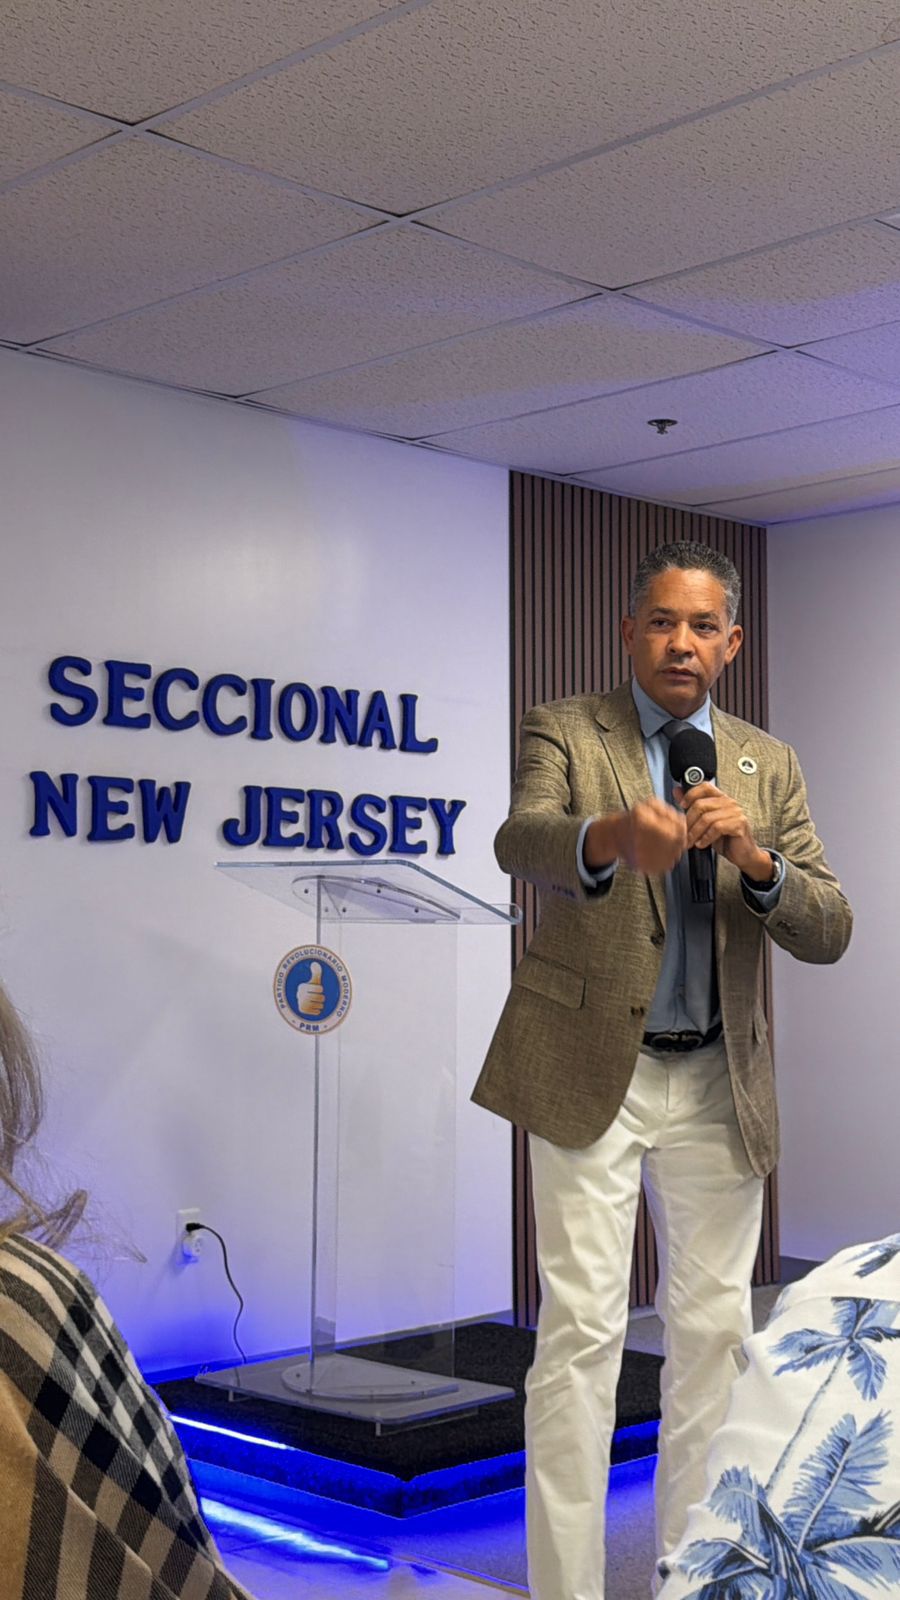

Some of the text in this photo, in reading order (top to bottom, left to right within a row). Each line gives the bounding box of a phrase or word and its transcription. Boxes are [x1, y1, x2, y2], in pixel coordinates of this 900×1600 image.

[48, 655, 439, 754] SECCIONAL
[28, 770, 467, 857] NEW JERSEY
[277, 948, 349, 1018] PARTIDO REVOLUCIONARIO MODERNO
[299, 1022, 320, 1032] PRM
